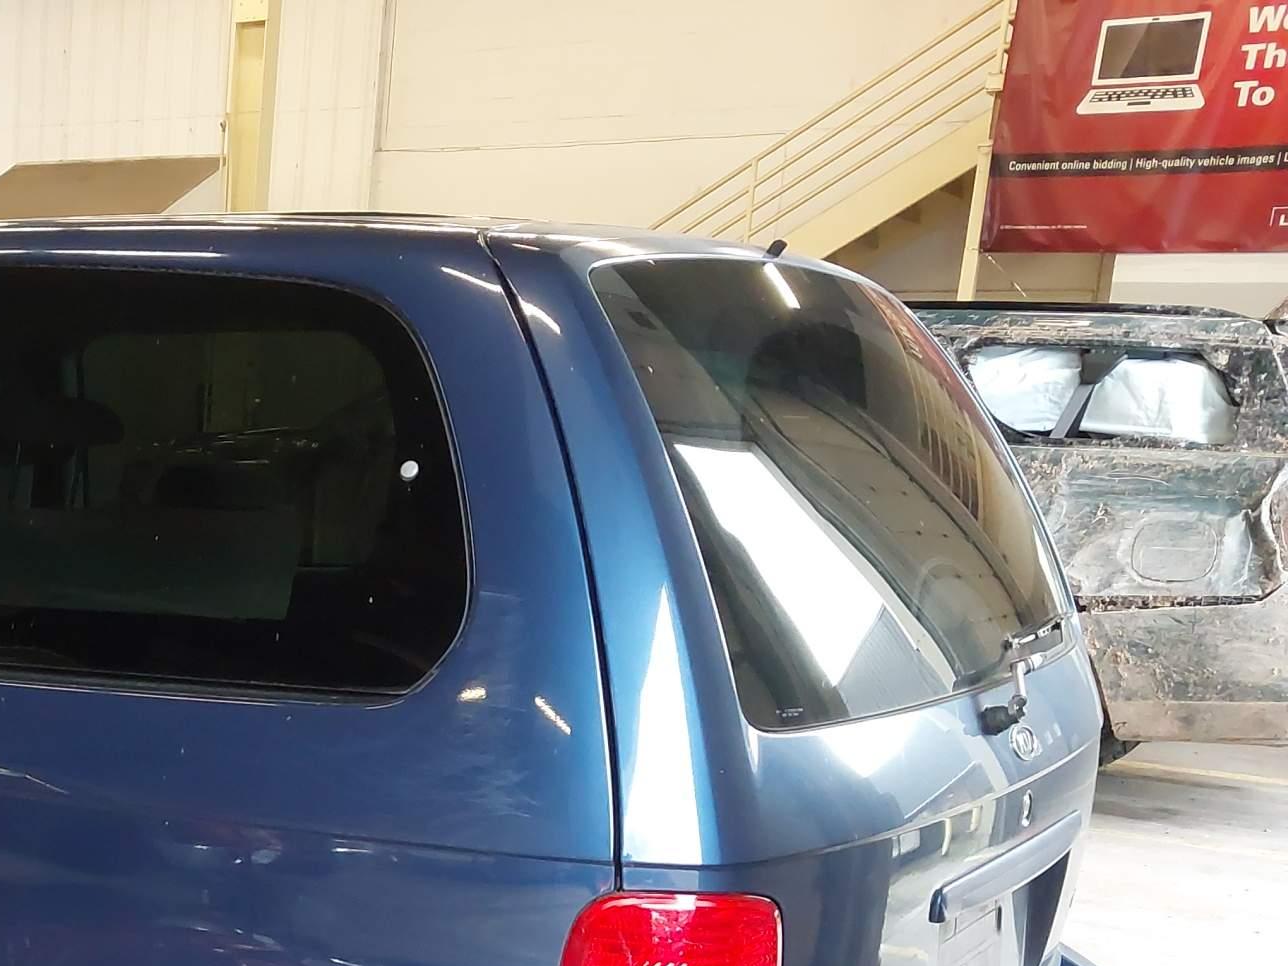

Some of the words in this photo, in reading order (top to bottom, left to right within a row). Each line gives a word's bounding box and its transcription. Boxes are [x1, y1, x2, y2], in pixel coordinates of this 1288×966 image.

[1249, 4, 1288, 33] W
[1233, 80, 1275, 107] To
[1008, 160, 1060, 171] Convenient
[1061, 160, 1091, 170] online
[1092, 159, 1128, 171] bidding
[1135, 156, 1195, 170] High-quality
[1197, 155, 1235, 166] vehicle
[1236, 154, 1275, 166] images
